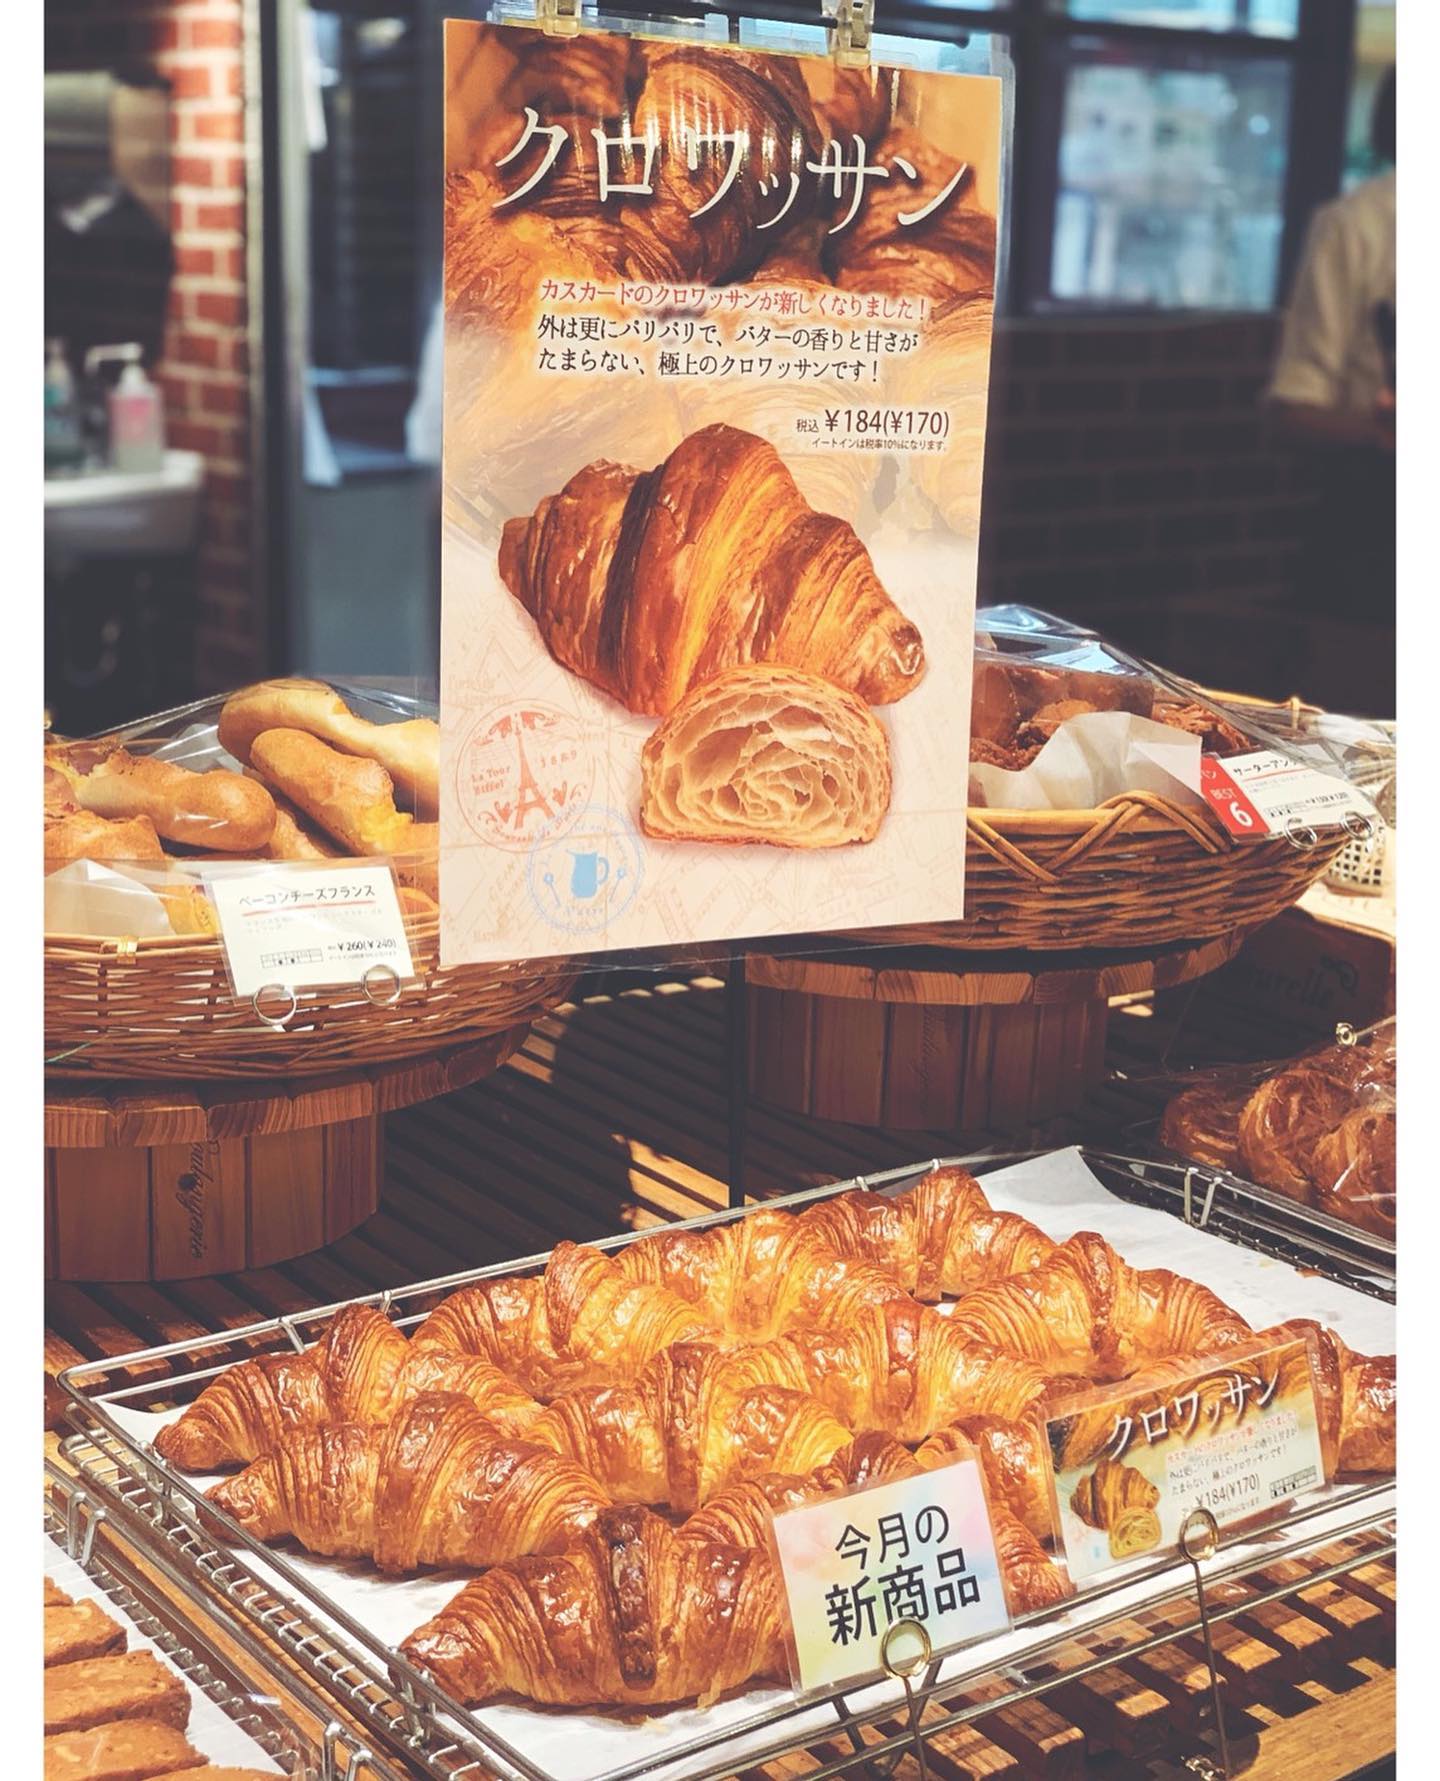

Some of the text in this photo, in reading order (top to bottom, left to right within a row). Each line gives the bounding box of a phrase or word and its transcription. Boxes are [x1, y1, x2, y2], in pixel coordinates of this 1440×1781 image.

[492, 107, 969, 235] クロワッサン
[540, 279, 927, 321] カスカードのクロワッサンが新しくなりました！
[537, 314, 919, 353] 外は更にパリパリで、バターの香りと甘さが
[538, 347, 879, 383] たまらない、極上のクロワッサンです！
[796, 418, 819, 433] 税込
[1229, 801, 1254, 828] 6
[238, 884, 376, 907] ベーコンチーズフランス
[1106, 1367, 1280, 1462] クロワッサン
[835, 1504, 950, 1571] 今月の
[823, 1547, 981, 1647] 新商品
